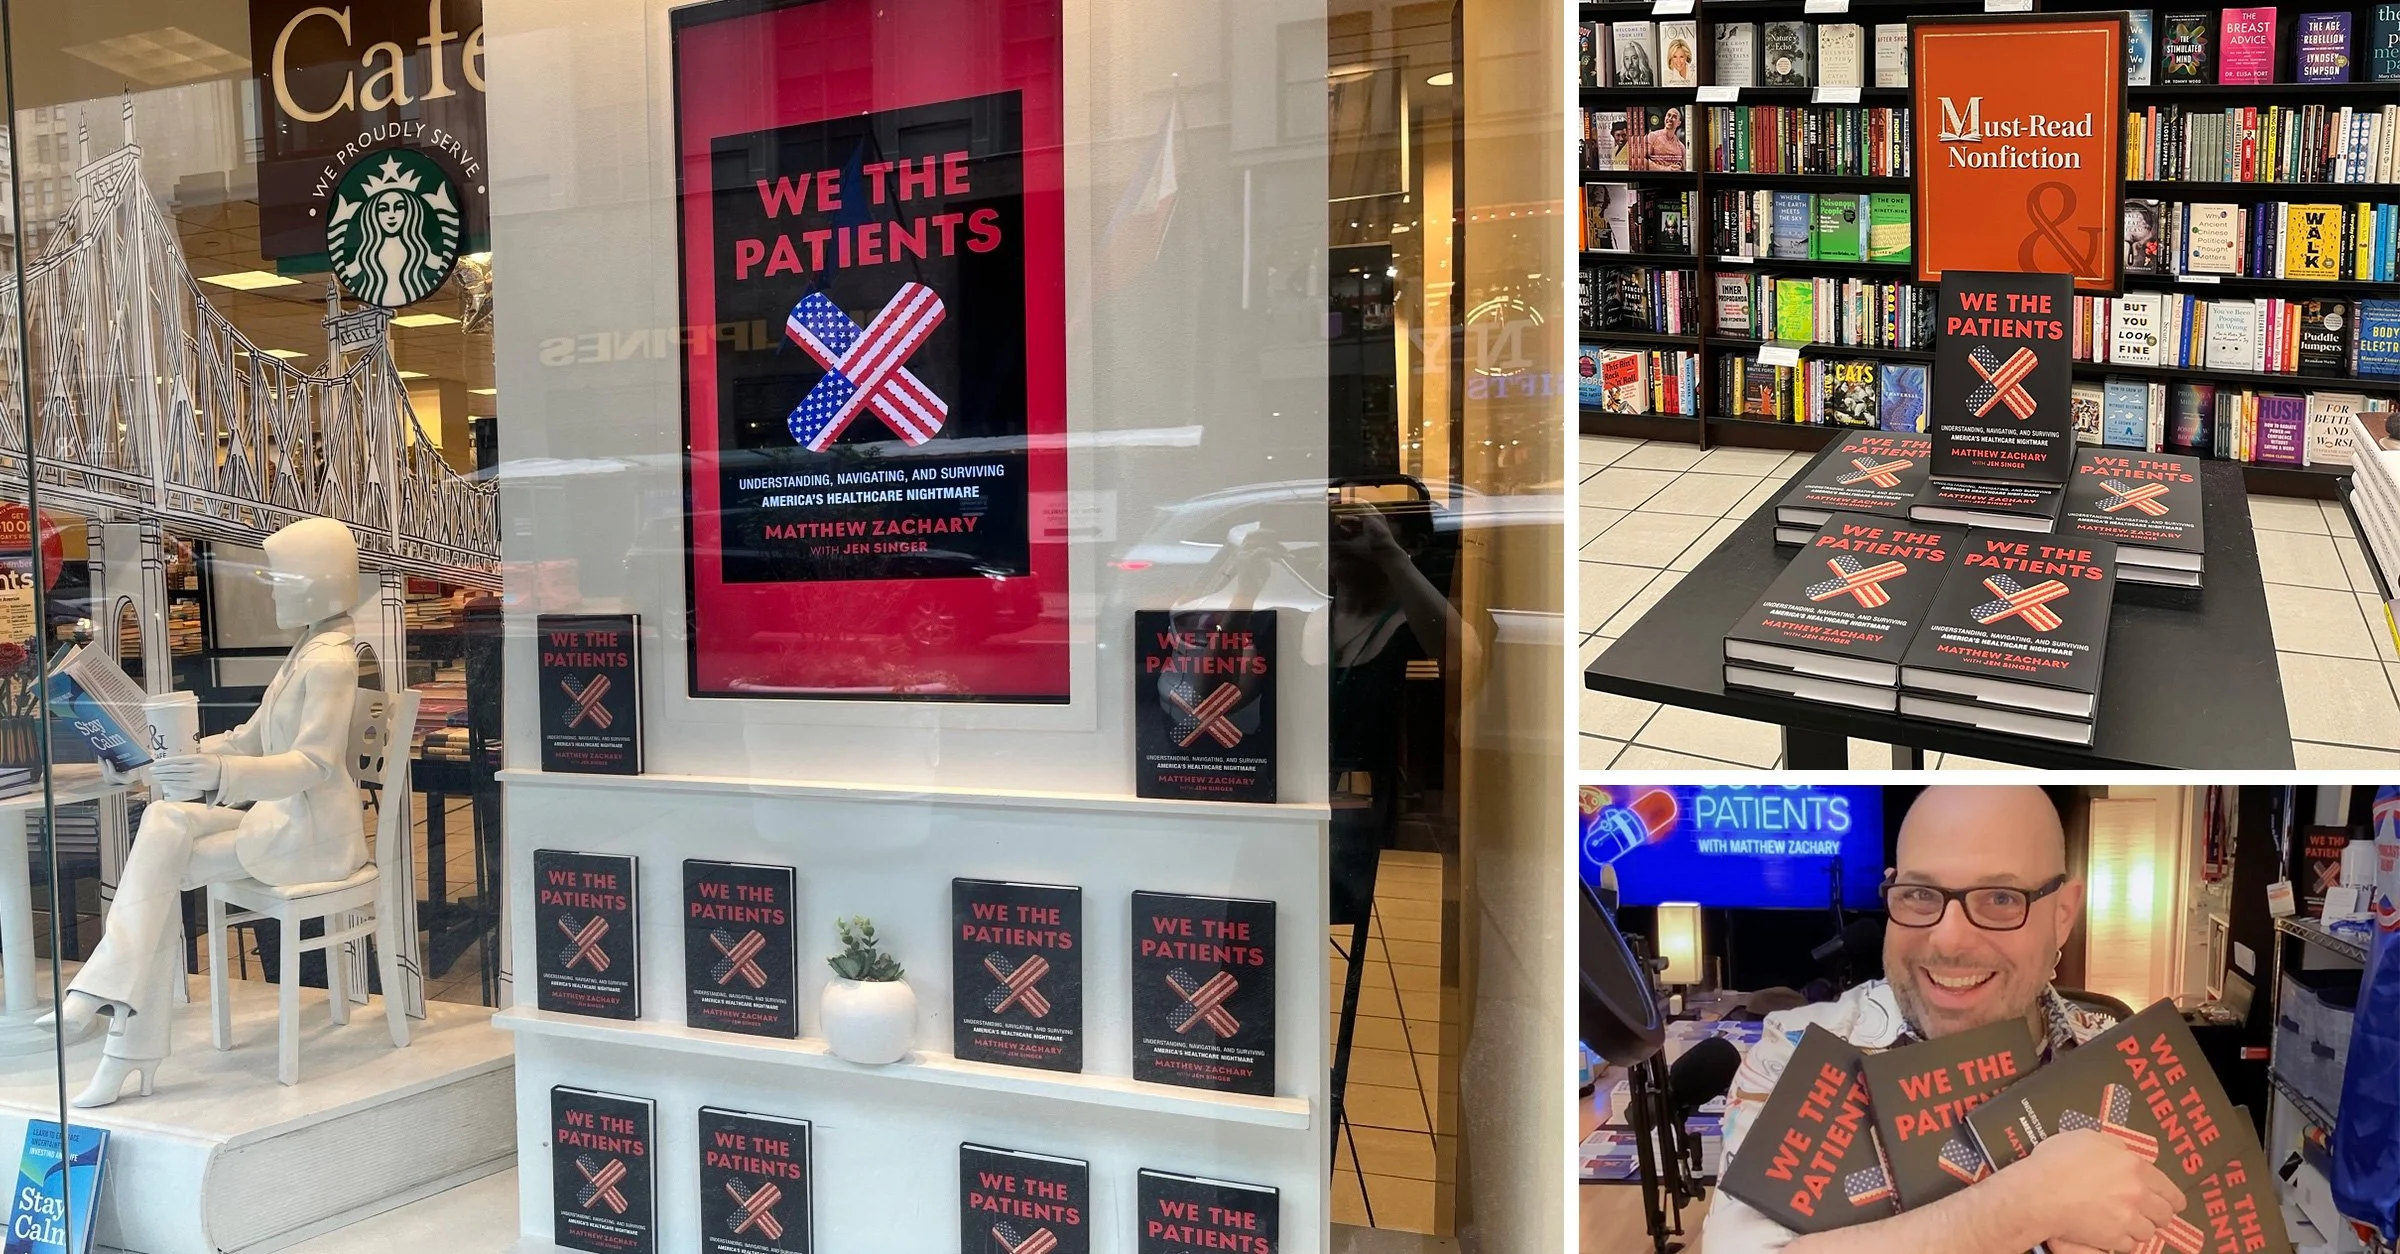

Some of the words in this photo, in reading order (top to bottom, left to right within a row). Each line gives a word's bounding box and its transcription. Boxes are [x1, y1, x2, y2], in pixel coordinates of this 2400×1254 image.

[2242, 12, 2257, 20] THE
[1664, 26, 1695, 39] JOAN
[2226, 22, 2271, 33] BREAST
[2309, 22, 2323, 31] THE
[2325, 22, 2340, 31] AGE
[1771, 34, 1797, 42] Nature's
[1775, 42, 1792, 50] Echo
[2230, 35, 2266, 44] ADVICE
[2303, 34, 2344, 44] REBELLION
[2166, 44, 2202, 53] STIMULATED
[2176, 55, 2192, 64] MIND
[2306, 53, 2339, 63] LYNDSEY
[2304, 66, 2340, 76] SIMPSON
[1937, 96, 2093, 139] Must-Read
[312, 166, 337, 198] WE
[337, 122, 425, 165] PROUDLY
[431, 129, 480, 178] SERVE
[1948, 145, 2081, 169] Nonfiction
[757, 169, 841, 218] WE
[863, 151, 971, 205] THE
[1820, 199, 1855, 209] Poisonous
[1820, 207, 1843, 215] People
[2205, 213, 2221, 221] Why
[735, 208, 1002, 280] PATIENTS
[2197, 237, 2228, 245] Political
[2305, 212, 2325, 269] WALK
[2197, 246, 2228, 254] Thought
[1722, 285, 1741, 294] INNER
[1960, 292, 1997, 312] WE
[2007, 294, 2052, 314] THE
[2124, 304, 2147, 312] BUT
[1947, 317, 2064, 340] PATIENTS
[2123, 317, 2148, 326] YOU
[2118, 331, 2152, 340] LOOK
[2304, 332, 2340, 342] Puddle
[2119, 346, 2149, 355] FINE
[2301, 342, 2342, 353] Jumpers
[1606, 361, 1619, 371] This
[1835, 363, 1874, 382] CATS
[1604, 372, 1619, 381] Rock
[1623, 374, 1636, 384] Roll
[2260, 400, 2305, 420] HUSH
[2326, 404, 2349, 413] FOR
[1941, 425, 1985, 434] UNDERSTANDING,
[1986, 427, 2018, 436] NAVIGATING,
[2020, 429, 2031, 437] AND
[2032, 430, 2060, 438] SURVIVING
[2324, 427, 2348, 436] AND
[1981, 436, 2015, 445] HEALTHCARE
[2016, 438, 2048, 447] NIGHTMARE
[1951, 448, 1999, 458] MATTHEW
[2000, 451, 2047, 462] ZACHARY
[2094, 456, 2129, 468] WE
[2138, 460, 2181, 472] THE
[739, 473, 833, 490] UNDERSTANDING,
[837, 469, 908, 484] NAVIGATING,
[912, 467, 938, 481] AND
[940, 464, 1005, 479] SURVIVING
[2080, 466, 2194, 483] PATIENTS
[827, 489, 903, 504] HEALTHCARE
[906, 486, 979, 501] NIGHTMARE
[764, 520, 867, 540] MATTHEW
[871, 516, 978, 536] ZACHARY
[1842, 525, 1883, 539] WE
[1892, 531, 1942, 546] THE
[810, 545, 839, 556] WITH
[843, 542, 869, 554] JEN
[874, 541, 928, 553] SINGER
[1815, 536, 1946, 562] PATIENTS
[1986, 540, 2029, 556] WE
[2040, 547, 2092, 563] THE
[1964, 553, 2103, 580] PATIENTS
[551, 632, 578, 647] WE
[585, 632, 618, 647] THE
[1156, 632, 1196, 650] WE
[1206, 632, 1253, 650] THE
[1931, 625, 1988, 638] UNDERSTANDING,
[1990, 632, 2032, 644] NAVIGATING,
[2035, 638, 2050, 646] AND
[2052, 640, 2089, 651] SURVIVING
[1981, 639, 2028, 651] HEALTHCARE
[2029, 645, 2073, 656] NIGHTMARE
[544, 653, 628, 668] PATIENTS
[1146, 656, 1267, 674] PATIENTS
[1936, 645, 2003, 659] MATTHEW
[2004, 654, 2069, 669] ZACHARY
[74, 718, 105, 736] Stay
[91, 733, 126, 751] Calm
[1694, 796, 1850, 831] PATIENTS
[1698, 839, 1728, 853] WITH
[1730, 840, 1786, 854] MATTHEW
[1788, 841, 1841, 855] ZACHARY
[548, 871, 576, 886] WE
[583, 873, 616, 889] THE
[541, 890, 627, 911] PATIENTS
[699, 883, 729, 899] WE
[736, 885, 774, 903] THE
[691, 903, 785, 925] PATIENTS
[971, 903, 1008, 921] WE
[1017, 906, 1061, 925] THE
[962, 924, 1073, 949] PATIENTS
[1152, 917, 1192, 936] WE
[1202, 920, 1250, 941] THE
[1141, 939, 1264, 966] PATIENTS
[1898, 1067, 1952, 1103] WE
[1957, 1050, 2017, 1087] THE
[2149, 1032, 2188, 1086] WE
[2180, 1086, 2222, 1147] THE
[2115, 1034, 2204, 1176] PATIENTS
[566, 1109, 594, 1128] WE
[600, 1115, 634, 1135] THE
[1764, 1127, 1812, 1181] WE
[1797, 1062, 1847, 1123] THE
[558, 1129, 644, 1156] PATIENTS
[715, 1132, 746, 1150] WE
[753, 1138, 789, 1157] THE
[707, 1151, 801, 1179] PATIENTS
[979, 1171, 1016, 1192] WE
[1024, 1178, 1068, 1201] THE
[19, 1187, 65, 1221] Stay
[969, 1192, 1081, 1225] PATIENTS
[1159, 1199, 1199, 1222] WE
[1209, 1206, 1256, 1230] THE
[2234, 1193, 2266, 1253] THE
[1148, 1221, 1270, 1254] PATIENTS
